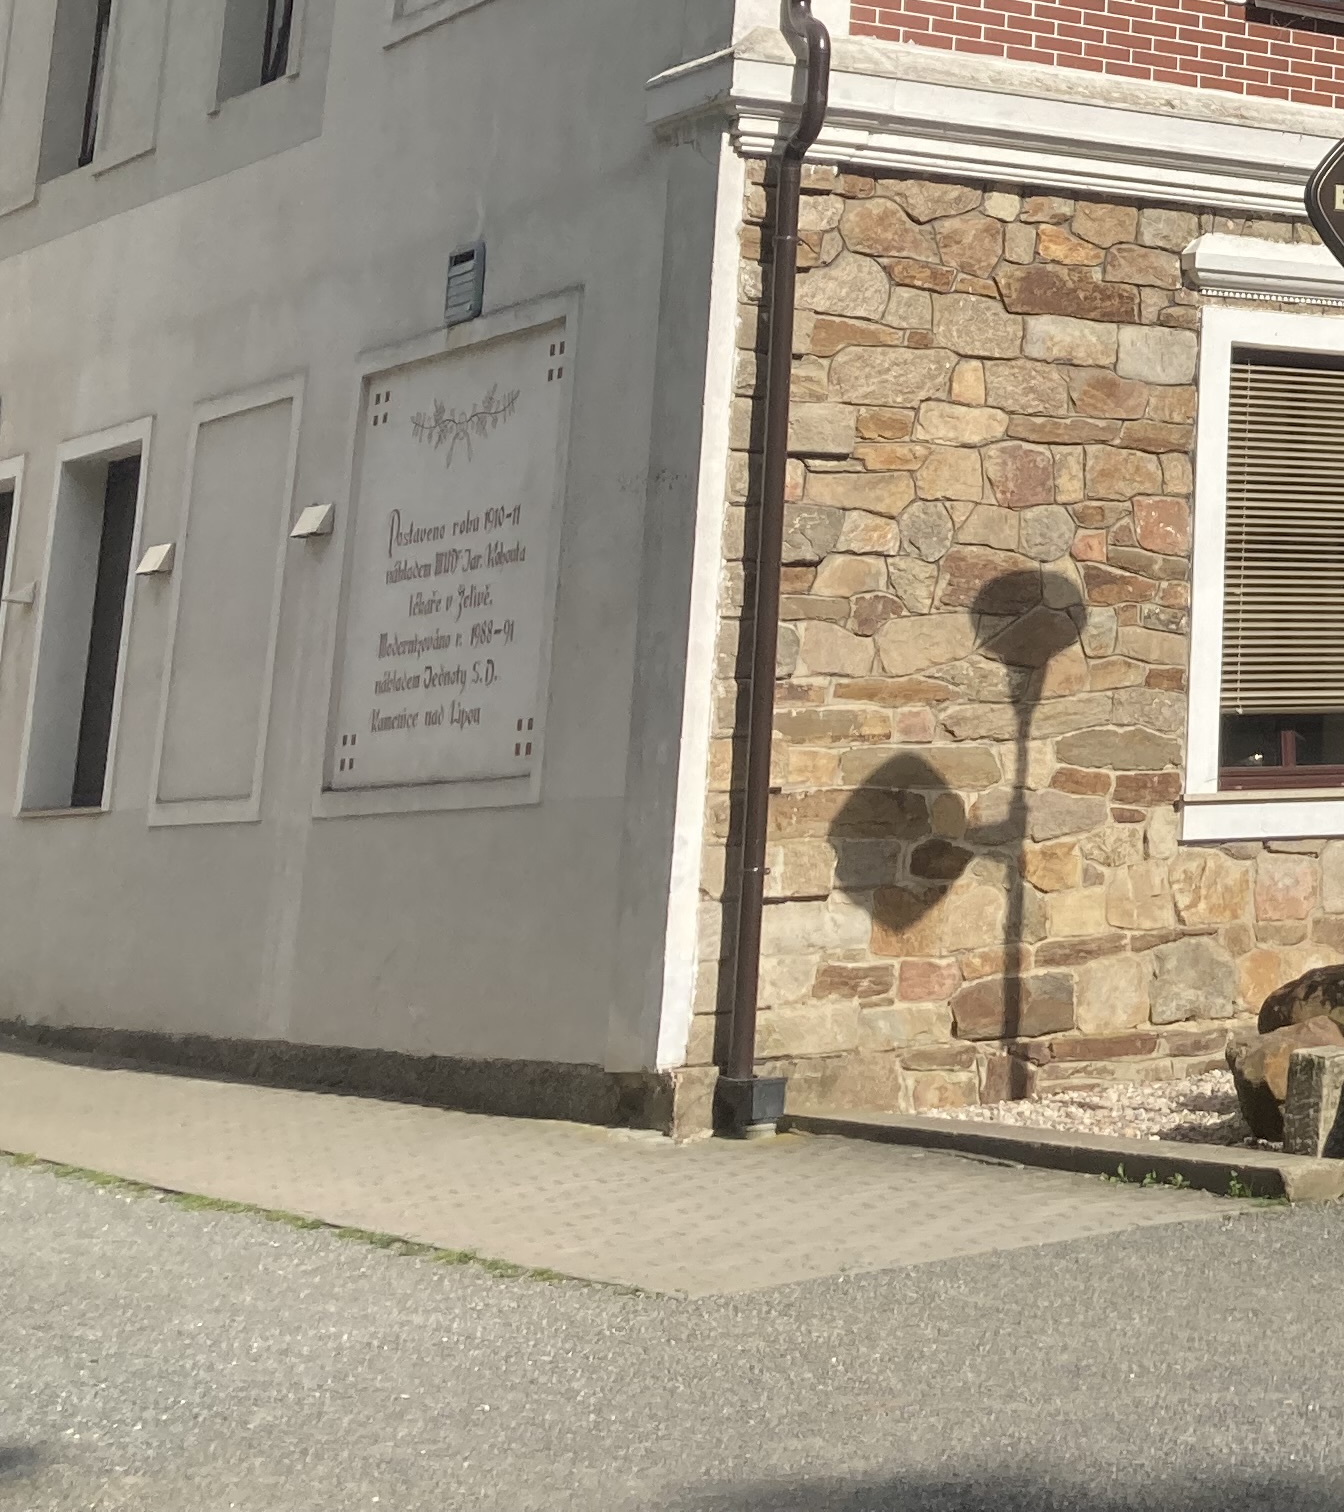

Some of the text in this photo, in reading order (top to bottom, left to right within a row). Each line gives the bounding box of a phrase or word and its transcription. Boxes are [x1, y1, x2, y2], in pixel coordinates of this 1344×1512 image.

[387, 508, 446, 559] Postaveno
[452, 510, 480, 537] roku
[386, 559, 431, 585] nákladem
[408, 589, 442, 617] lékaře
[446, 595, 453, 612] v
[375, 670, 420, 696] nákladem
[423, 664, 467, 696] Jednoty
[370, 700, 481, 733] Kamenice nad Lipou
